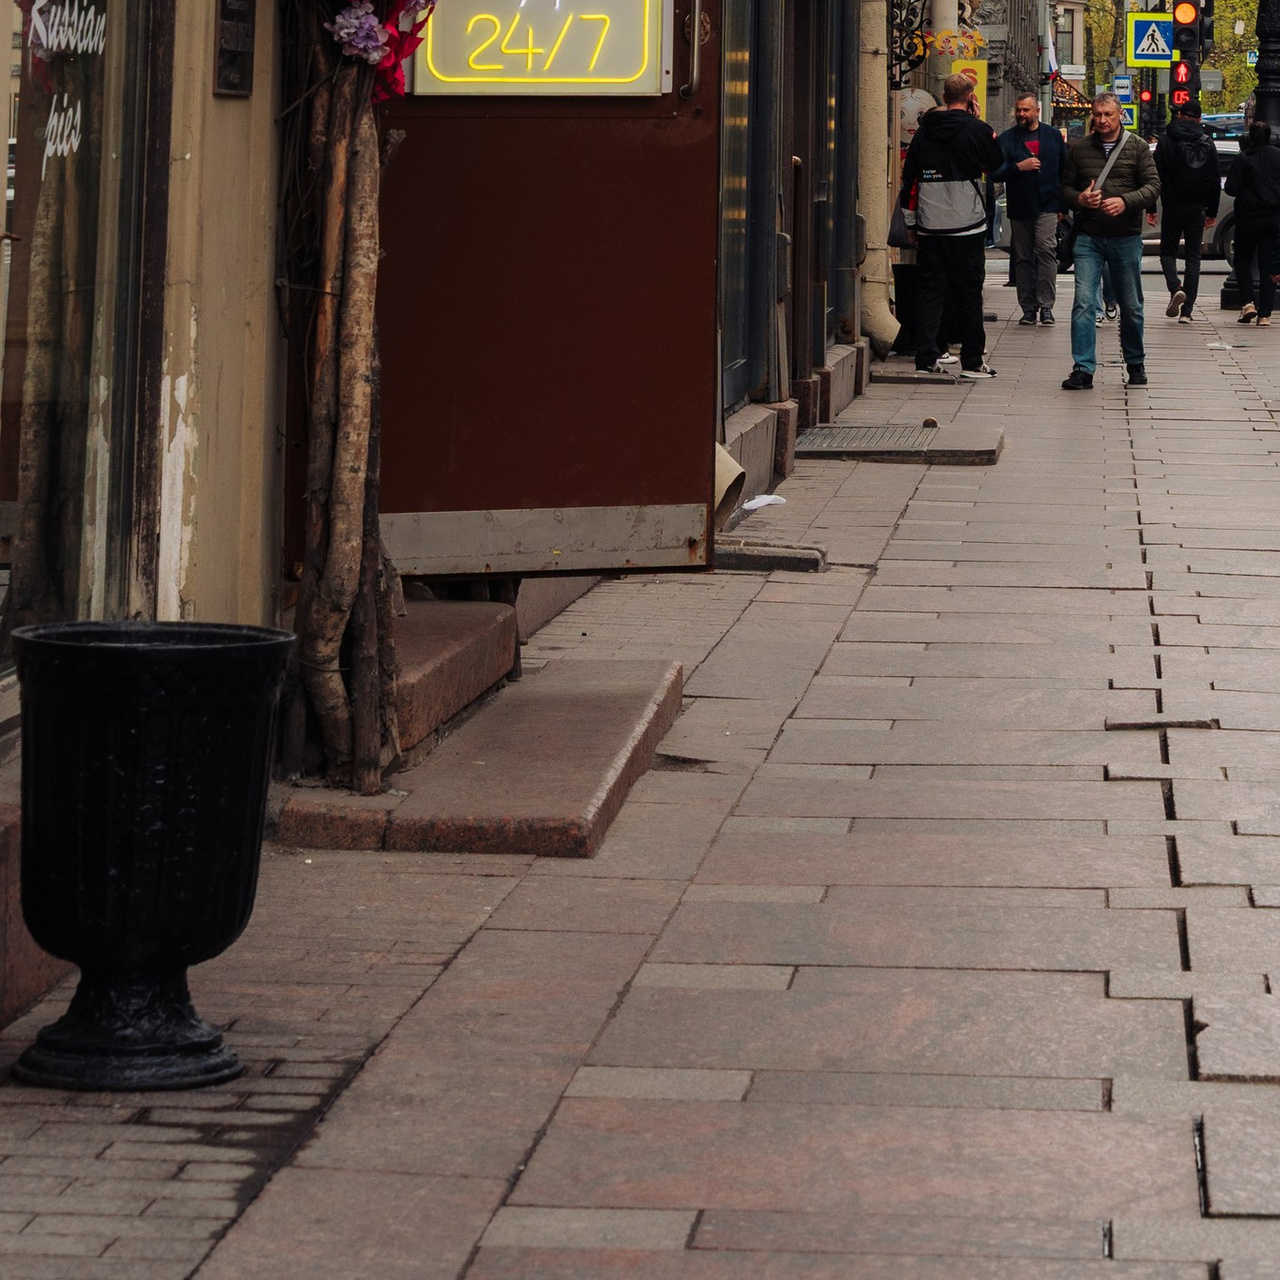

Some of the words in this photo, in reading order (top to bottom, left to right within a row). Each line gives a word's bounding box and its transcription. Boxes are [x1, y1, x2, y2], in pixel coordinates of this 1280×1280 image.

[465, 11, 611, 72] 24/7
[1174, 90, 1190, 105] 05
[41, 92, 82, 182] pies
